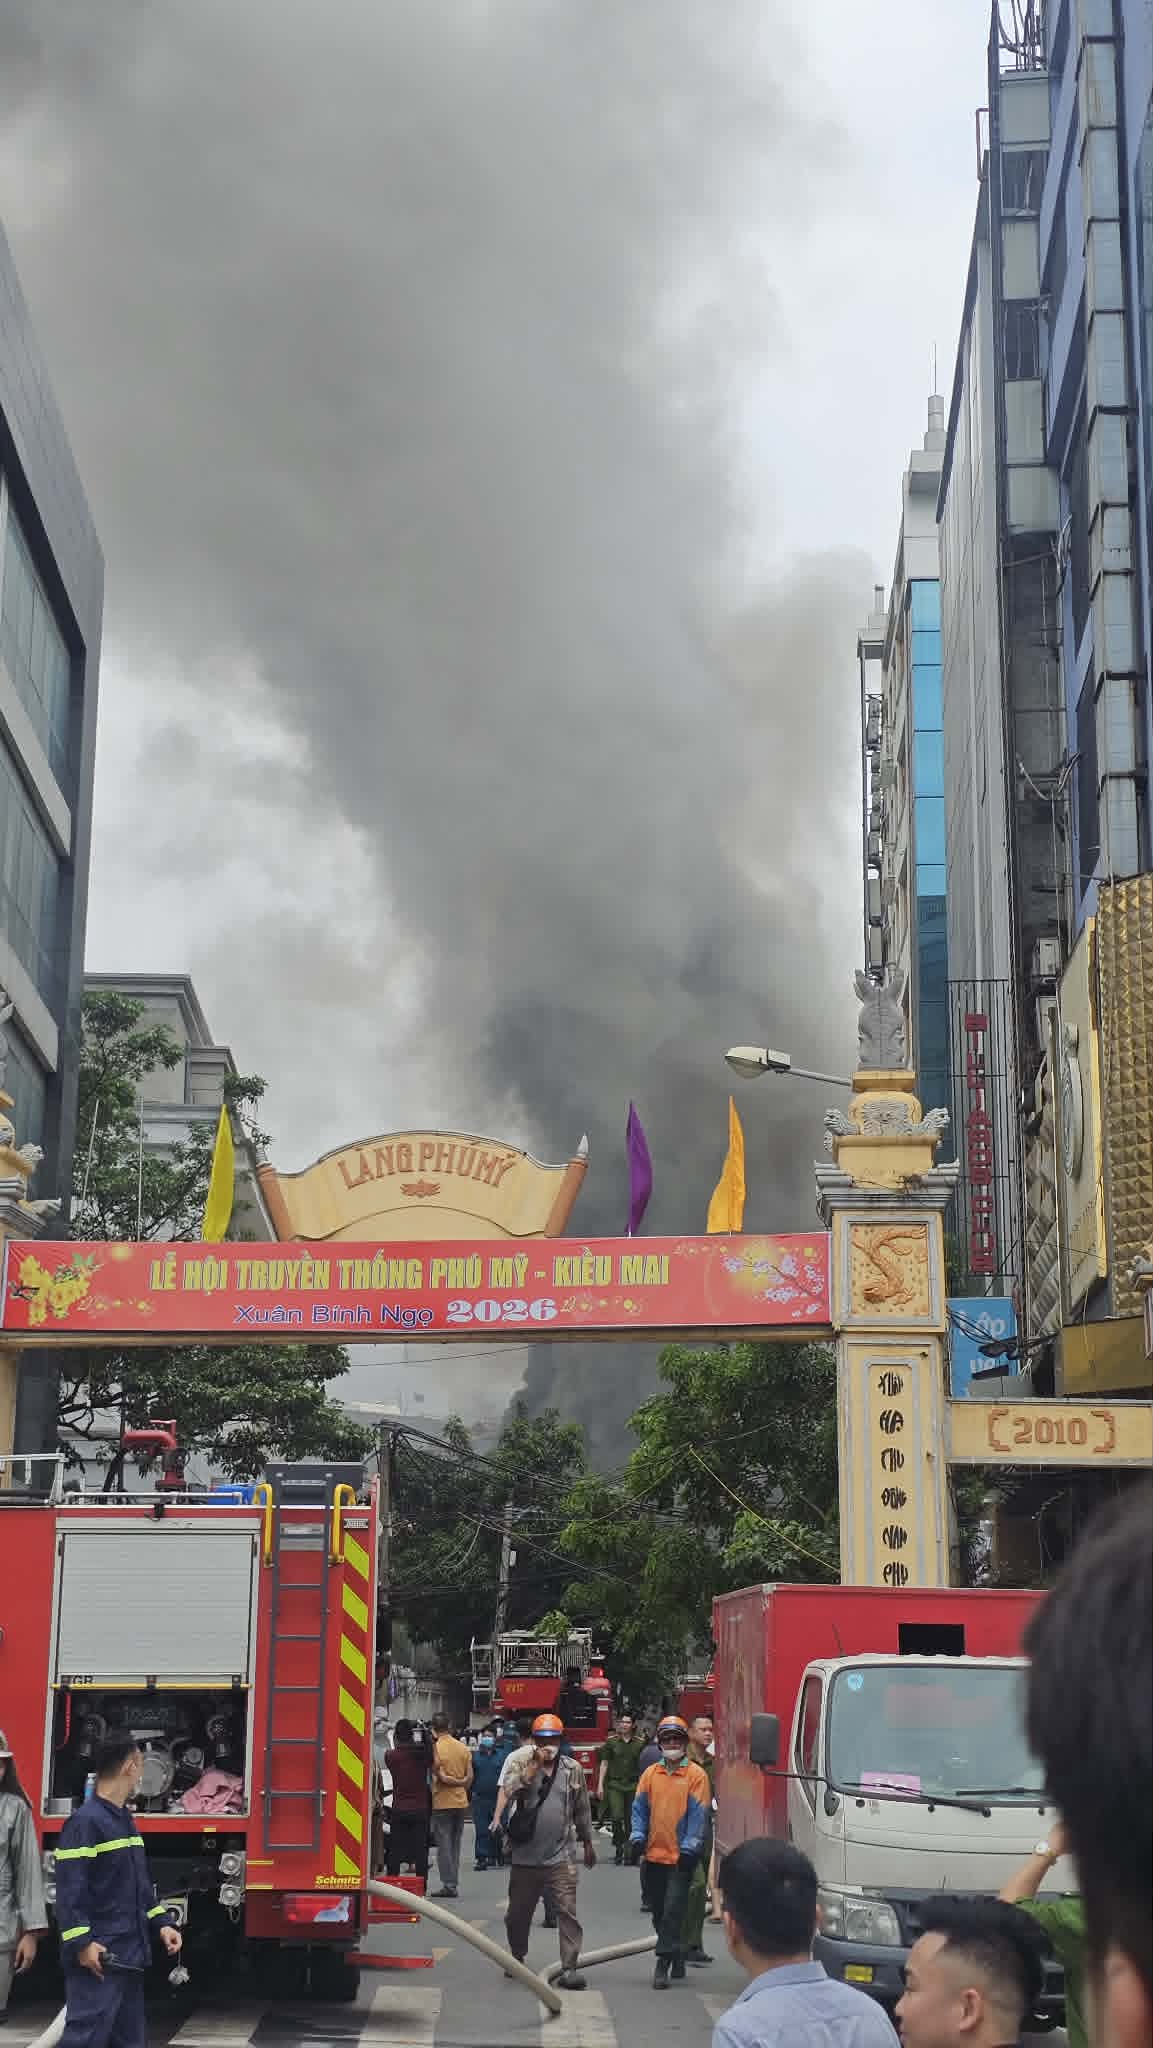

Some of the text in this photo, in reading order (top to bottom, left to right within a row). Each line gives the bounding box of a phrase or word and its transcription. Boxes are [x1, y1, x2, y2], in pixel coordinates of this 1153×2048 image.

[151, 1246, 671, 1296] LỄ HỘI TRUYỀN THỐNG PHÚ MỸ - KIỀU MAI
[233, 1298, 559, 1328] Xuân Bính Ngọ 2026
[880, 1408, 904, 1434] HẠ
[1013, 1416, 1088, 1445] 2010
[881, 1446, 905, 1473] THU
